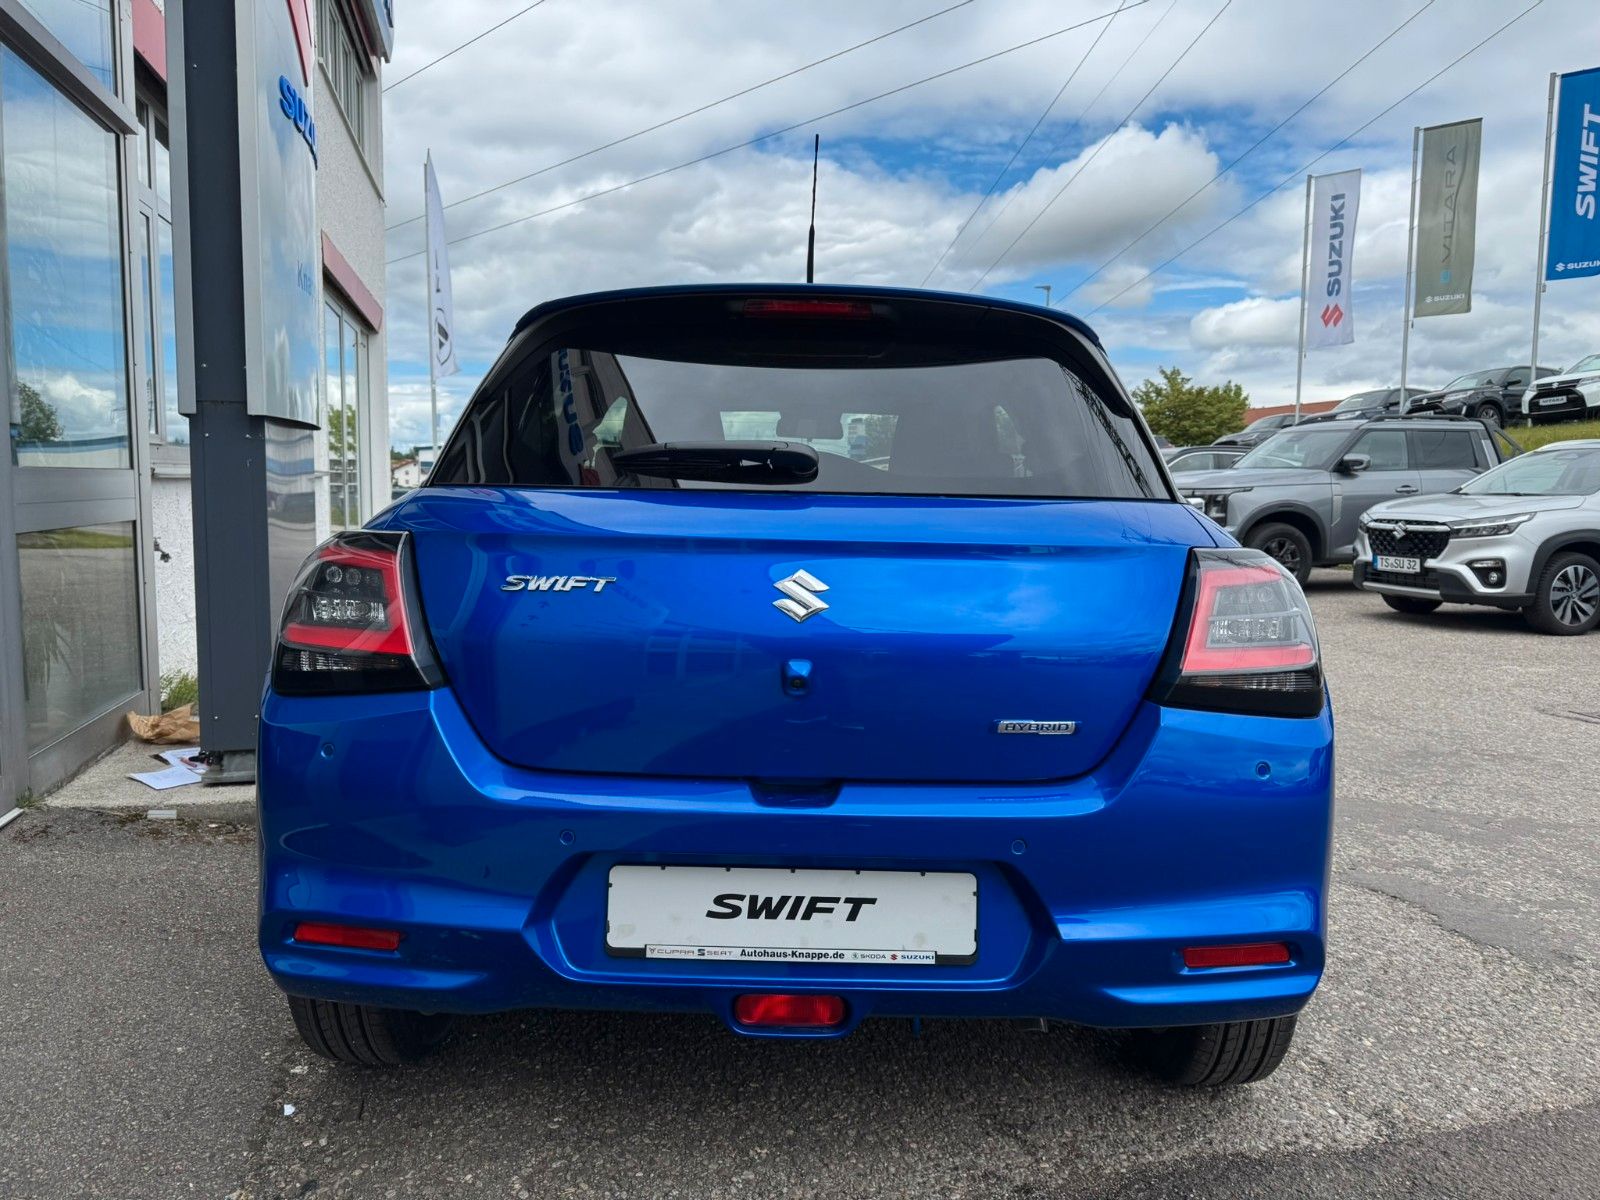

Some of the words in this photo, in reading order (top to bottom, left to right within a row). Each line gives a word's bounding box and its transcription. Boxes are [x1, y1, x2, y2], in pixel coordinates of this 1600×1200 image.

[1576, 103, 1600, 220] SWIFT
[1442, 145, 1457, 263] VITARA
[1327, 193, 1346, 297] SUZUKI
[1434, 294, 1465, 302] SUZUKI
[1379, 557, 1390, 568] TS
[1394, 558, 1405, 569] SU
[1406, 559, 1417, 570] 32
[500, 574, 617, 592] SWIFT
[1003, 721, 1071, 733] HYBRID
[705, 893, 878, 922] SWIFT
[656, 948, 695, 956] CUPRA
[740, 948, 845, 960] Autohaus-Knappe.de
